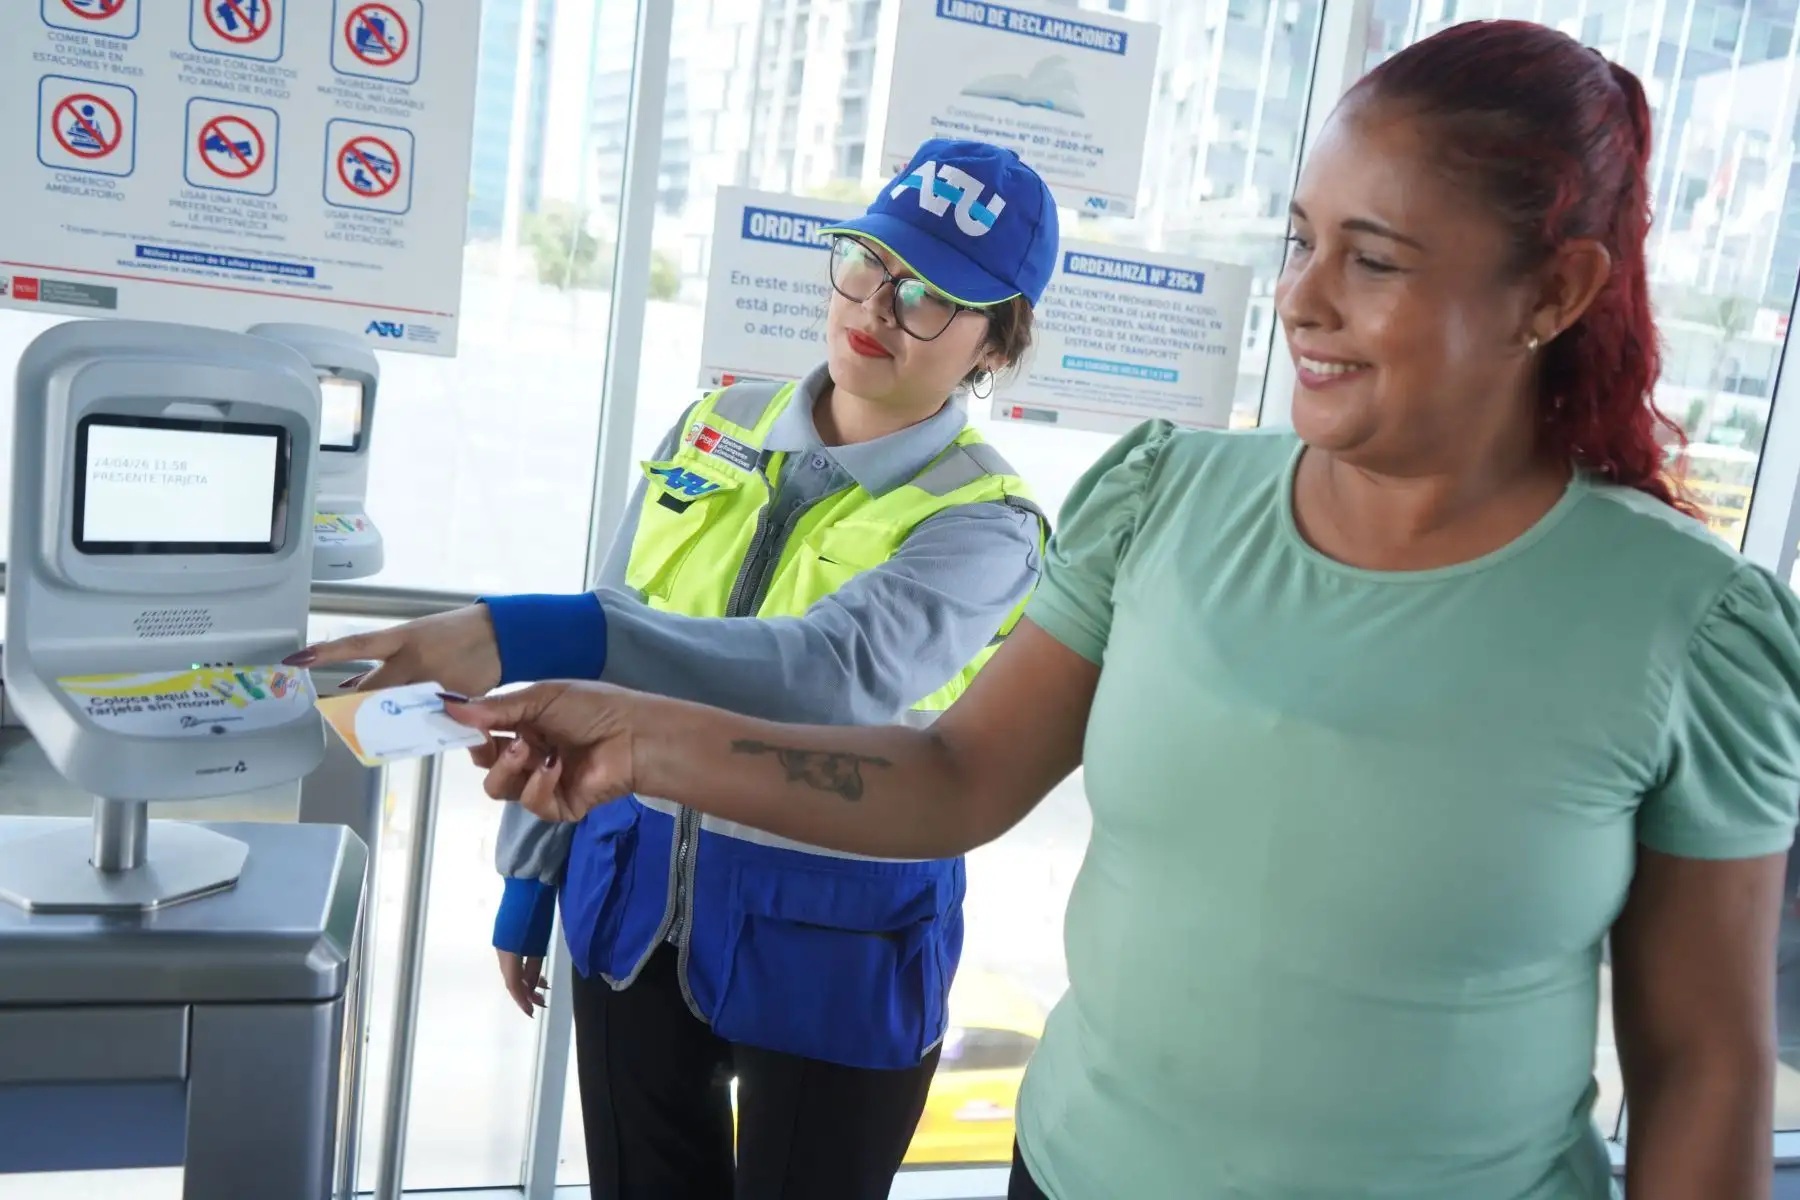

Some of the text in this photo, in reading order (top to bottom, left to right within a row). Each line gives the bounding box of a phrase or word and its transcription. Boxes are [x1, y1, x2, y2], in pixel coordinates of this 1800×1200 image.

[942, 0, 1121, 51] LIBRO DE RECLAMACIONES
[68, 45, 105, 59] FUMAR
[108, 52, 124, 62] EN
[94, 38, 128, 51] BEBER
[33, 52, 100, 70] ESTACIONES
[170, 50, 298, 79] INGRESAR CON OBJETOS
[183, 64, 286, 87] PUNZO CORTANTES
[200, 78, 235, 91] ARMAS
[238, 83, 251, 93] DE
[255, 86, 291, 100] FUEGO
[931, 116, 972, 131] Decreto
[973, 124, 1017, 140] Supremo
[55, 173, 116, 189] COMERCIO
[45, 183, 125, 201] AMBULATORIO
[180, 188, 278, 211] USAR UNA TARJETA
[889, 160, 1006, 237] ATU
[168, 198, 288, 223] PREFERENCIAL QUE NO
[750, 212, 834, 248] ORDENA
[731, 270, 751, 286] En
[755, 277, 788, 292] este
[1070, 255, 1147, 282] ORDENANZA
[1167, 270, 1198, 291] 2154
[1059, 284, 1116, 302] ENCUENTRA
[736, 296, 768, 312] está
[1070, 299, 1083, 309] EN
[1085, 301, 1123, 314] CONTRA
[1126, 308, 1138, 317] DE
[1140, 310, 1157, 320] LAS
[1210, 320, 1222, 330] EN
[1045, 309, 1089, 323] ESPECIAL
[364, 320, 404, 338] ATU
[744, 322, 755, 334] o
[760, 324, 796, 339] acto
[799, 328, 818, 342] de
[1064, 337, 1103, 351] SISTEMA
[1105, 343, 1116, 352] DE
[1094, 327, 1113, 339] QUE
[1116, 331, 1126, 341] SE
[1129, 333, 1190, 350] ENCUENTREN
[1192, 343, 1205, 352] EN
[1206, 344, 1228, 356] ESTE
[93, 471, 208, 486] PRESENTE TARJETA
[650, 466, 721, 496] ATU
[86, 697, 226, 716] Tarjeta sin mover
[90, 695, 149, 706] Coloca
[192, 690, 209, 699] tu
